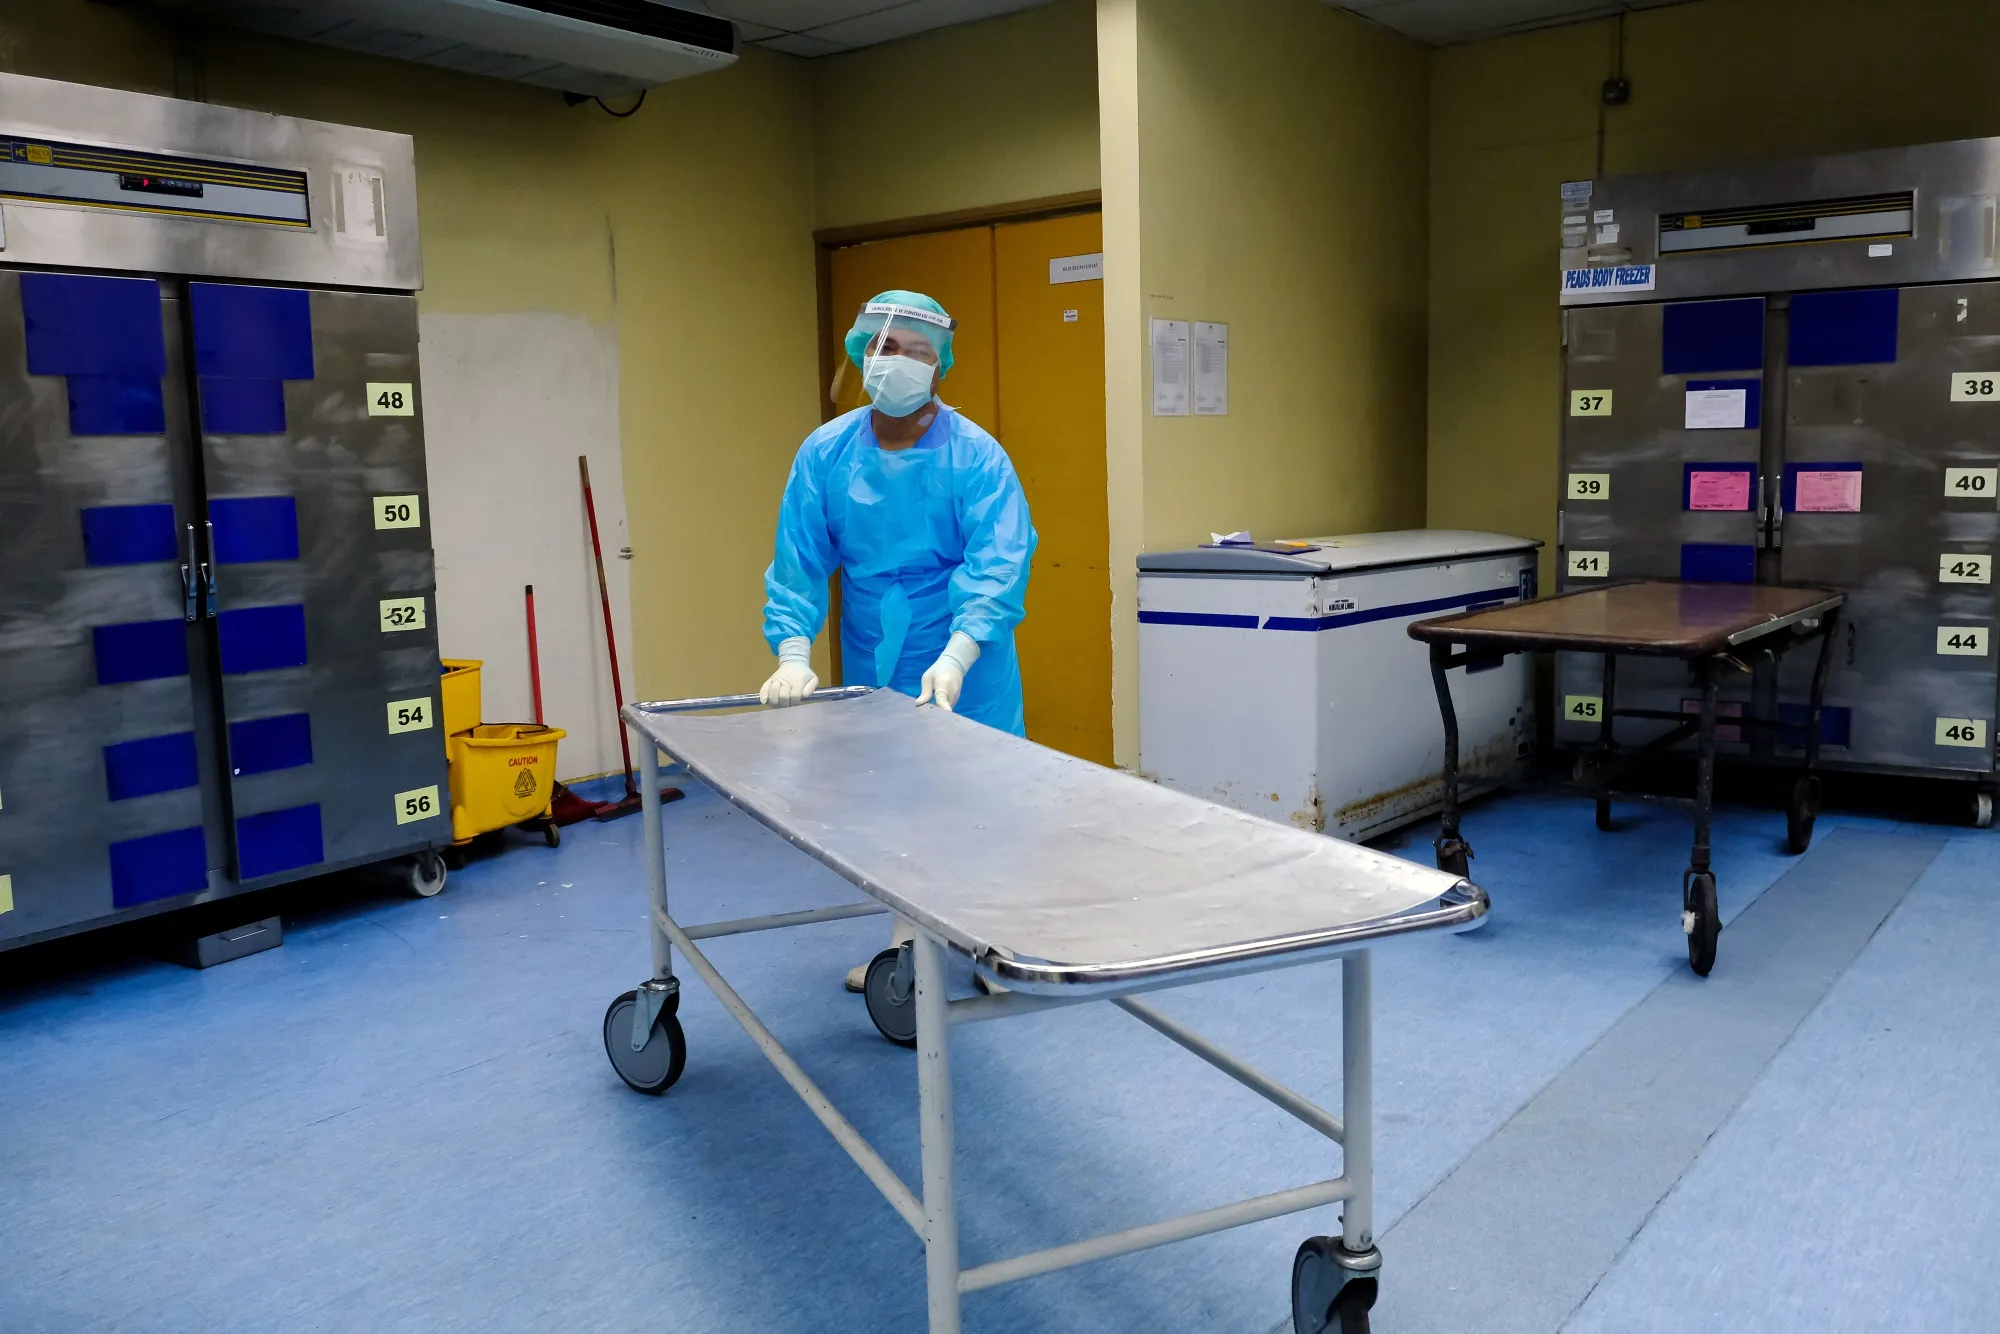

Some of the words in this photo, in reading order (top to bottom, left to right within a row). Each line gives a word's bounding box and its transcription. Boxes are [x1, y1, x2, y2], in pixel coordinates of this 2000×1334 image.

[1566, 269, 1591, 288] PEADS
[1592, 267, 1615, 287] BODY
[1615, 264, 1651, 286] FREEZER
[1964, 380, 1994, 396] 38
[377, 391, 404, 409] 48
[1579, 397, 1604, 411] 37
[1576, 480, 1601, 495] 39
[1955, 475, 1986, 491] 40
[385, 504, 410, 523] 50
[1576, 558, 1599, 572] 41
[1949, 561, 1980, 577] 42
[389, 606, 416, 626] 52
[1947, 635, 1978, 650] 44
[398, 707, 424, 726] 54
[1572, 701, 1597, 717] 45
[1945, 725, 1975, 742] 46
[508, 755, 538, 767] CAUTION
[405, 796, 431, 816] 56
